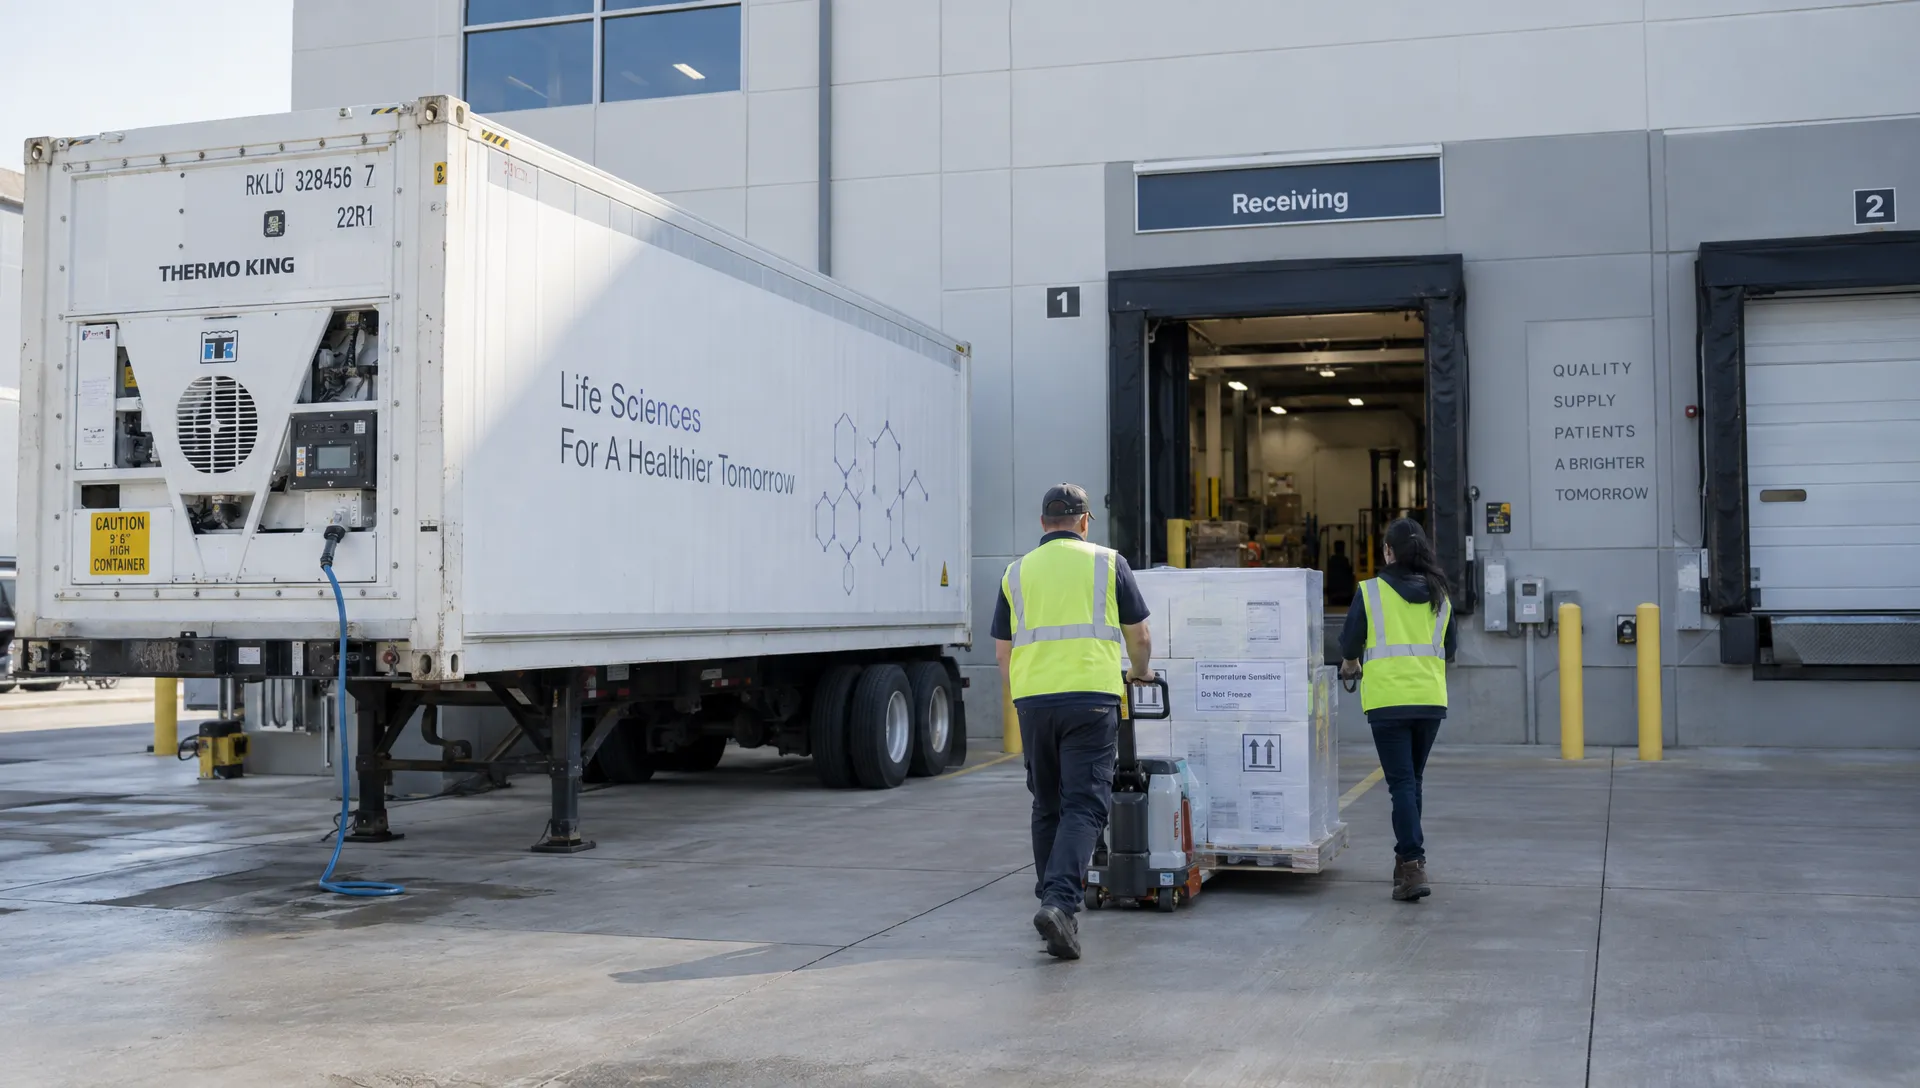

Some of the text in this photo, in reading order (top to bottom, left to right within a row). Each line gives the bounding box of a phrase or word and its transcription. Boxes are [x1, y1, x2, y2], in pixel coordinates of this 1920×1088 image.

[295, 166, 352, 192] 328456
[365, 164, 375, 187] 7
[1232, 188, 1349, 214] Receiving
[1865, 194, 1885, 218] 2
[337, 205, 373, 228] 22R1
[159, 257, 295, 282] THERMO KING
[1056, 291, 1068, 313] 1
[1553, 362, 1632, 378] QUALITY
[561, 370, 701, 433] Life Sciences
[1553, 394, 1616, 408] SUPPLY
[1554, 425, 1636, 440] PATIENTS
[561, 427, 796, 496] For A Healthier Tomorrow
[1555, 456, 1646, 471] A BRIGHTER
[1555, 486, 1649, 501] TOMORROW
[95, 516, 145, 531] CAUTION
[109, 545, 130, 556] HIGH
[93, 558, 145, 571] CONTAINER
[1201, 672, 1281, 682] Temperature Sensitive
[1201, 690, 1252, 698] Do Not Freeze
